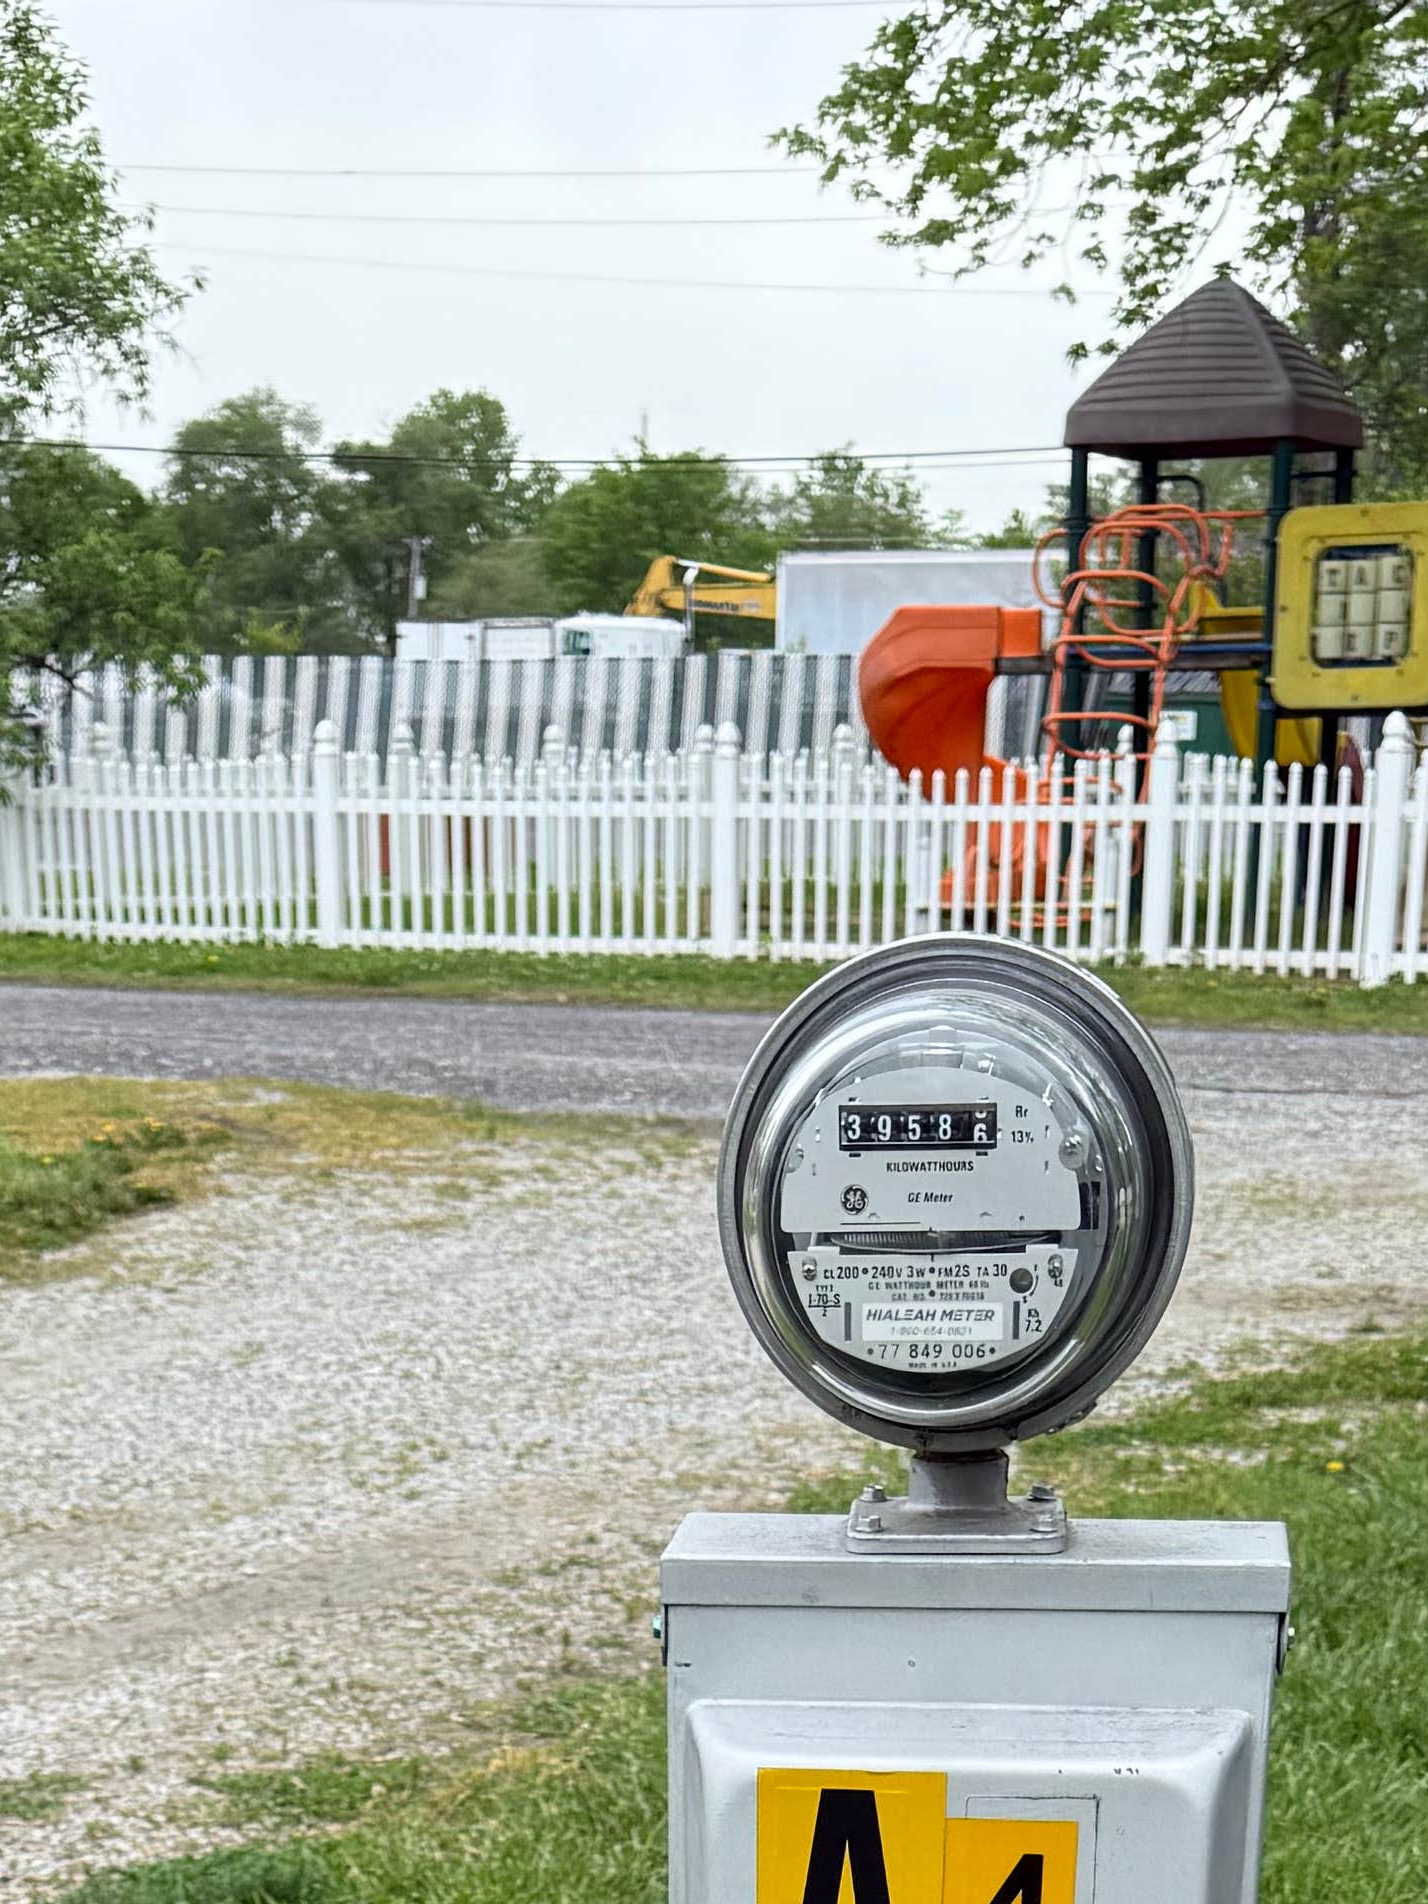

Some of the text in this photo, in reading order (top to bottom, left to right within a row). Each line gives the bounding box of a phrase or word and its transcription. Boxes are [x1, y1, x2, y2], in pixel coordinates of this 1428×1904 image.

[886, 1161, 974, 1173] KILOWATTHOURS
[907, 1192, 954, 1204] GE Meter
[866, 1308, 995, 1321] HIALEAH METER
[908, 1343, 943, 1359] 849
[952, 1343, 987, 1359] 006
